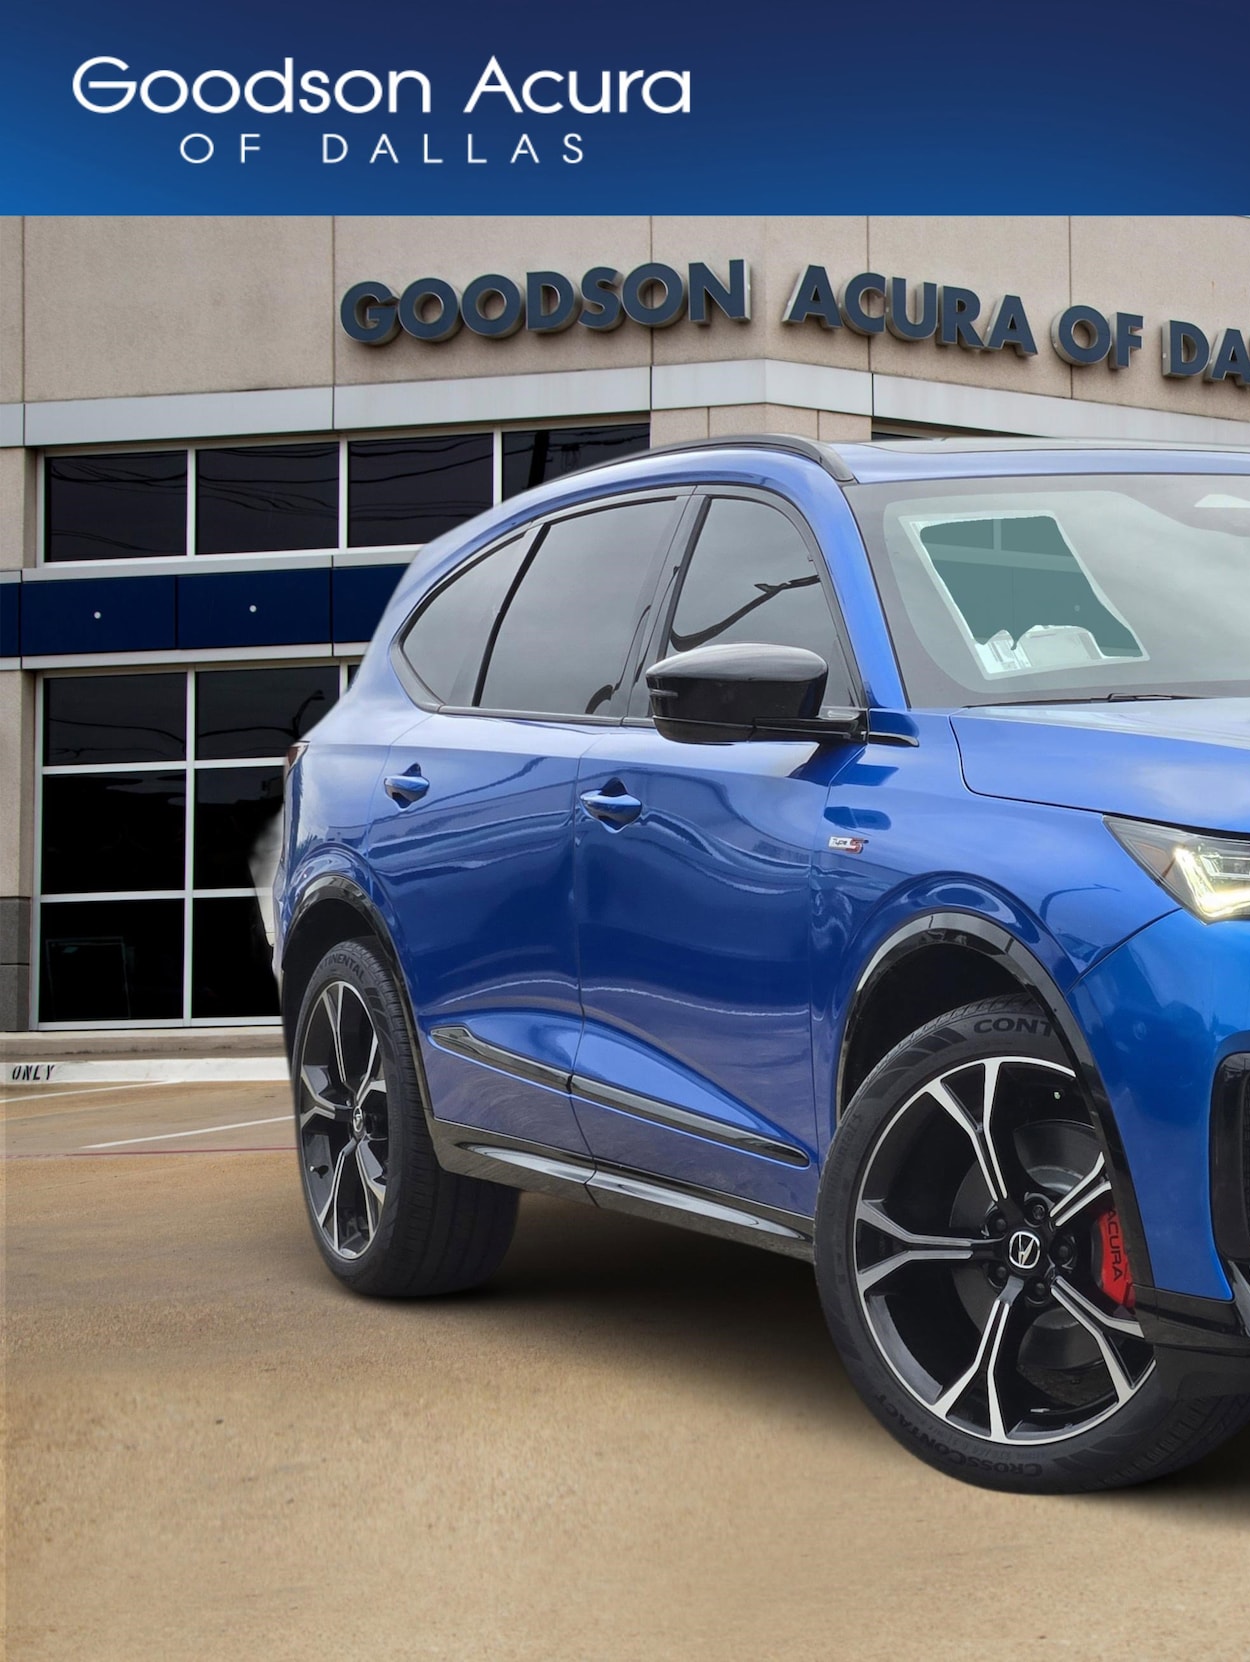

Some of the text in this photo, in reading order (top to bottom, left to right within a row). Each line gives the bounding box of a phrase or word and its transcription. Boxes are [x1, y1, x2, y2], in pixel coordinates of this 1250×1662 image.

[340, 258, 752, 348] GOODSON
[782, 264, 1038, 358] ACURA
[1051, 304, 1145, 370] OF
[12, 1064, 55, 1081] ONLY
[1107, 1209, 1123, 1282] ACURA
